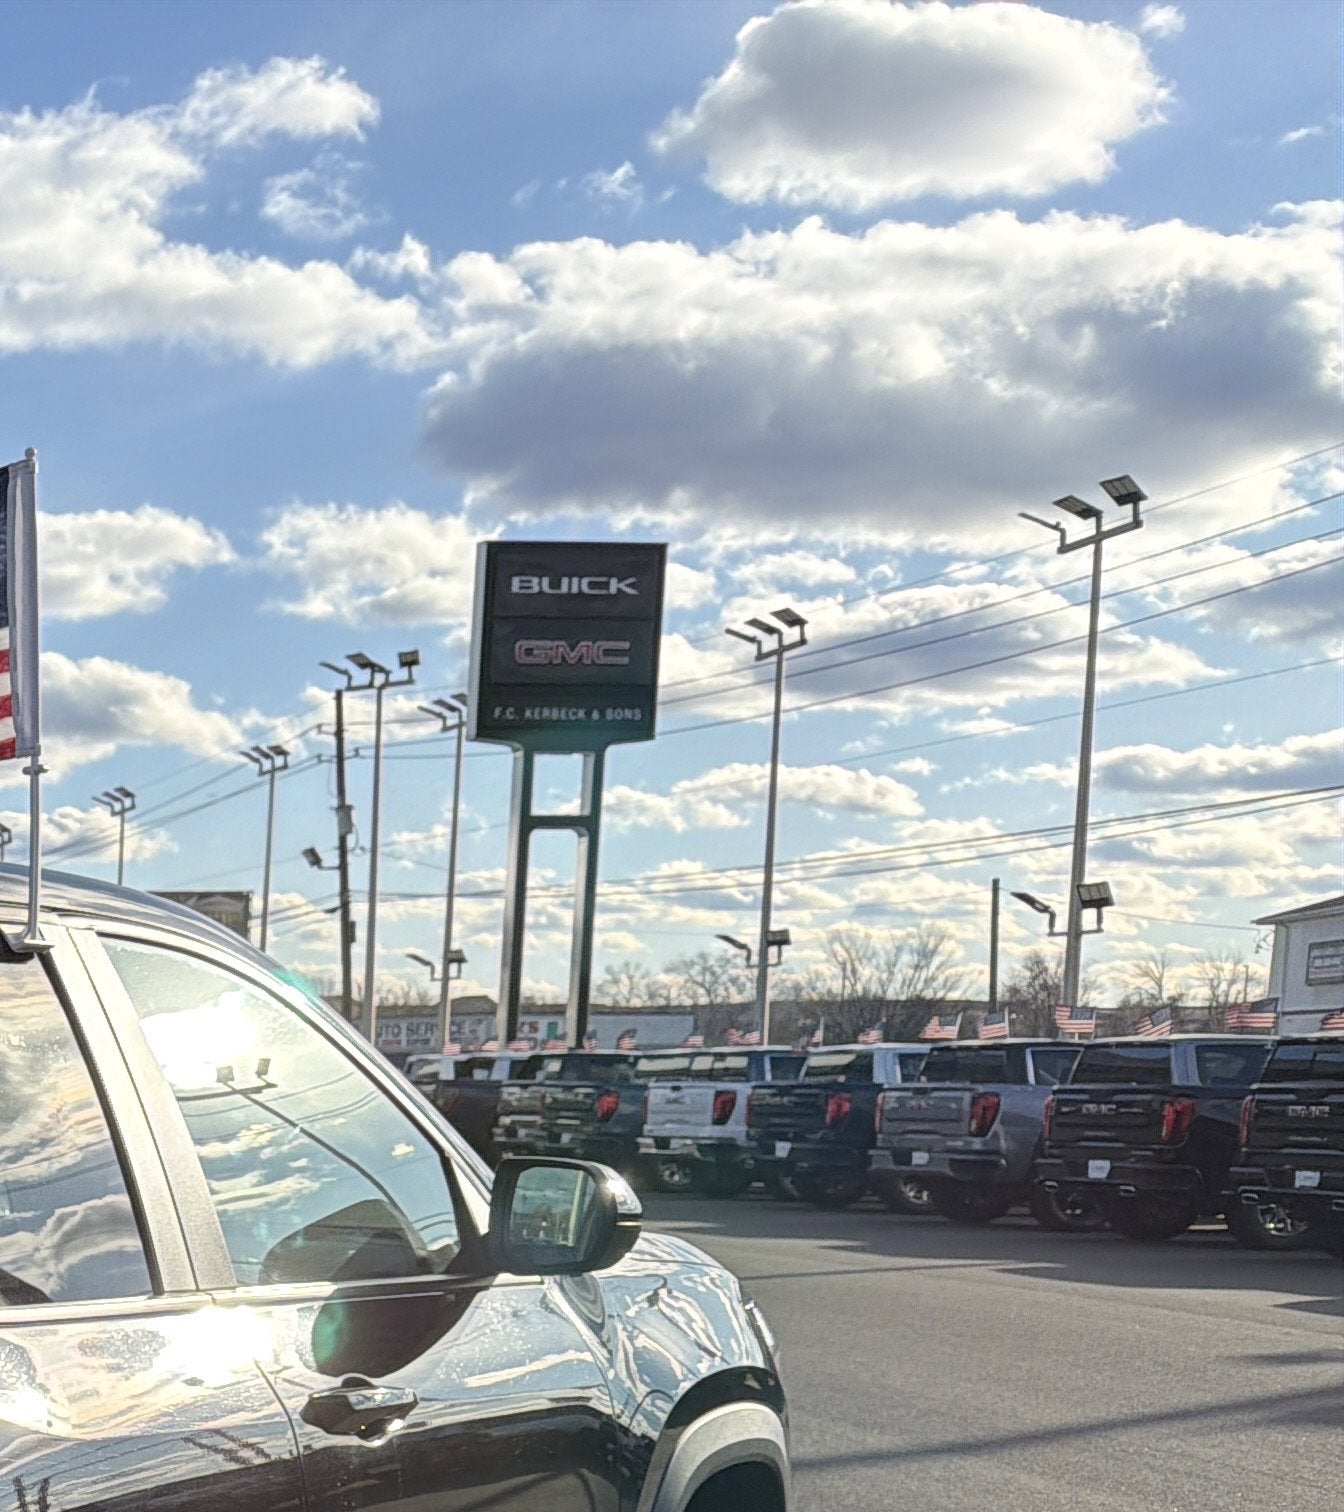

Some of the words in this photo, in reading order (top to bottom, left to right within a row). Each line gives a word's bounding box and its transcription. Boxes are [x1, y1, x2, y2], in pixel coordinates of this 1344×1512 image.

[511, 576, 639, 595] BUICK
[515, 639, 630, 665] GMC
[493, 706, 519, 720] F.C.
[524, 707, 586, 720] KERBECK
[606, 708, 642, 721] SONS
